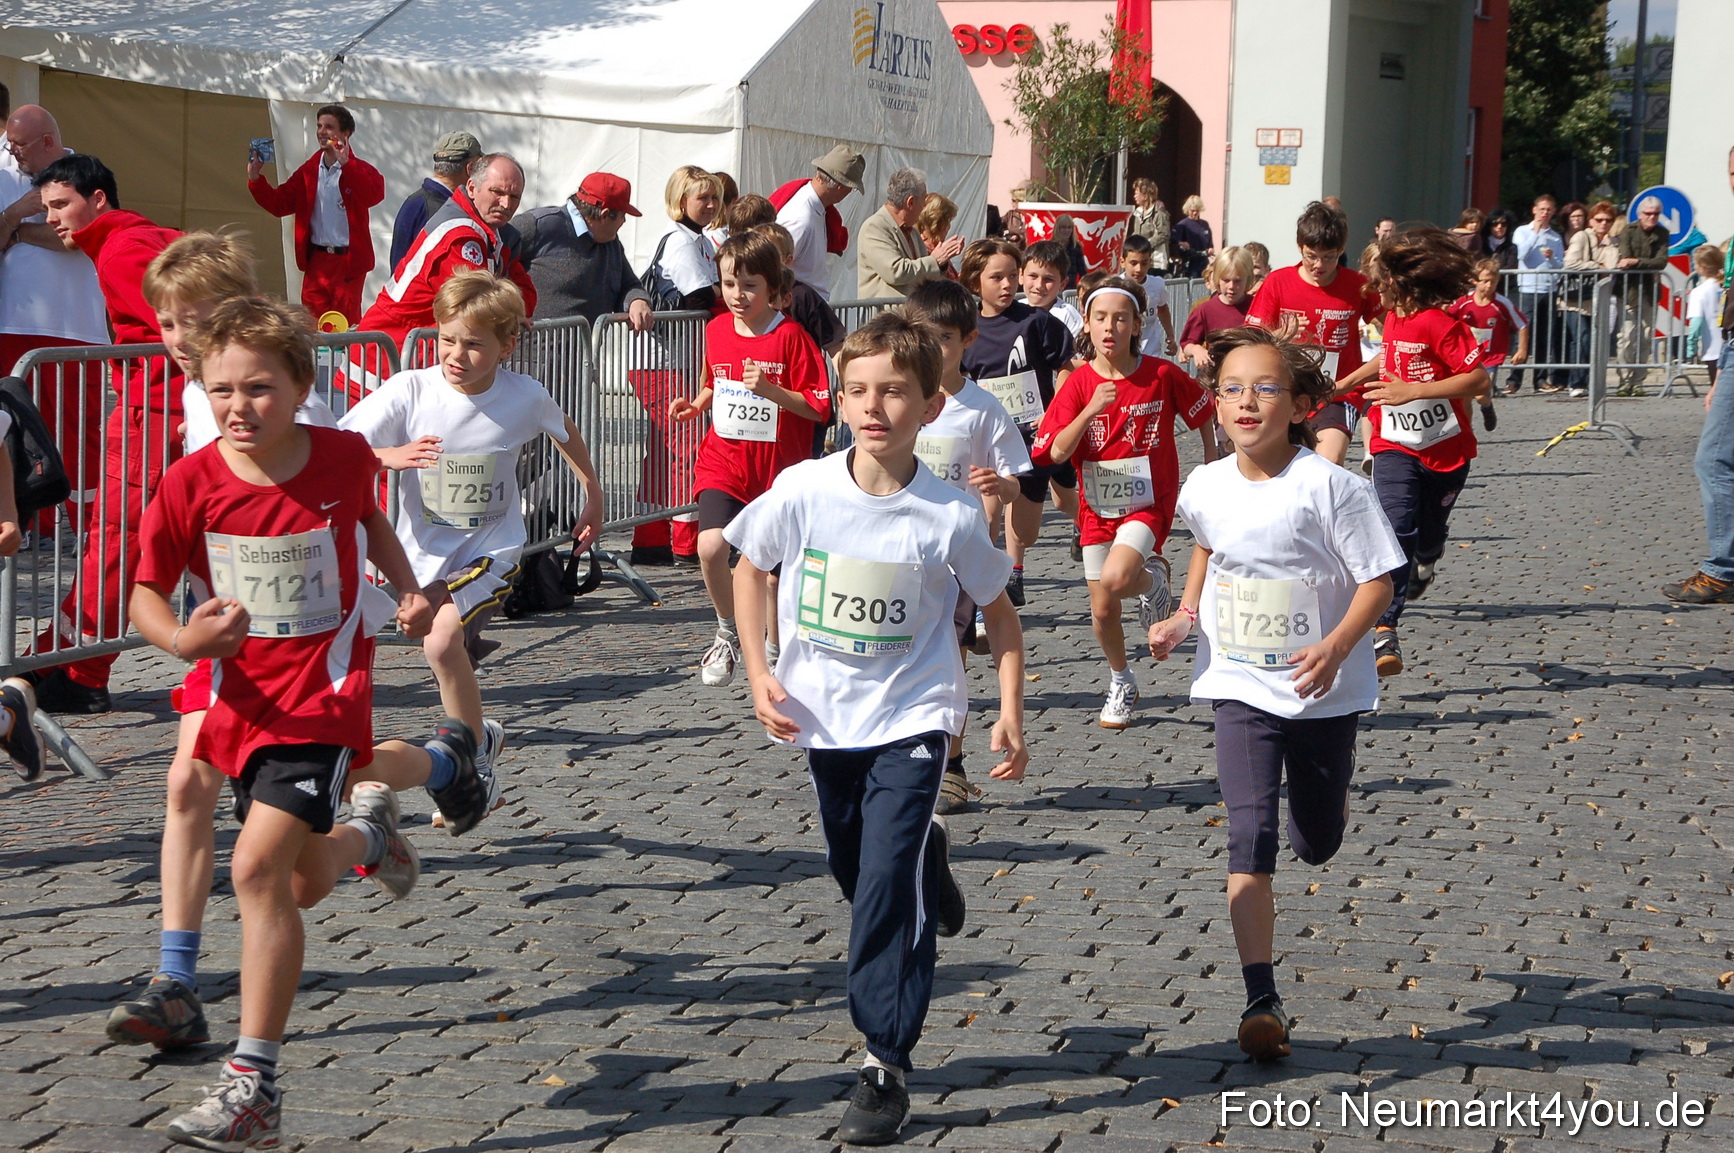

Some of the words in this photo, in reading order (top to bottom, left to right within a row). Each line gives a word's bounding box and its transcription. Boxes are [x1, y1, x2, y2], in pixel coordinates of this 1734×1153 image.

[991, 381, 1016, 392] Aaron
[727, 403, 771, 423] 7325
[1388, 403, 1448, 431] 10209
[914, 441, 942, 455] iklas
[446, 460, 485, 475] Simon
[1096, 463, 1141, 478] Cornelius
[447, 481, 505, 504] 7251
[1100, 480, 1146, 499] 7259
[239, 543, 323, 564] Sebastian
[215, 569, 224, 584] K
[244, 569, 325, 603] 7121
[1237, 583, 1258, 603] Leo
[831, 591, 907, 625] 7303
[1219, 606, 1225, 620] K
[1239, 612, 1310, 638] 7238
[866, 641, 911, 652] PFLEIDERER
